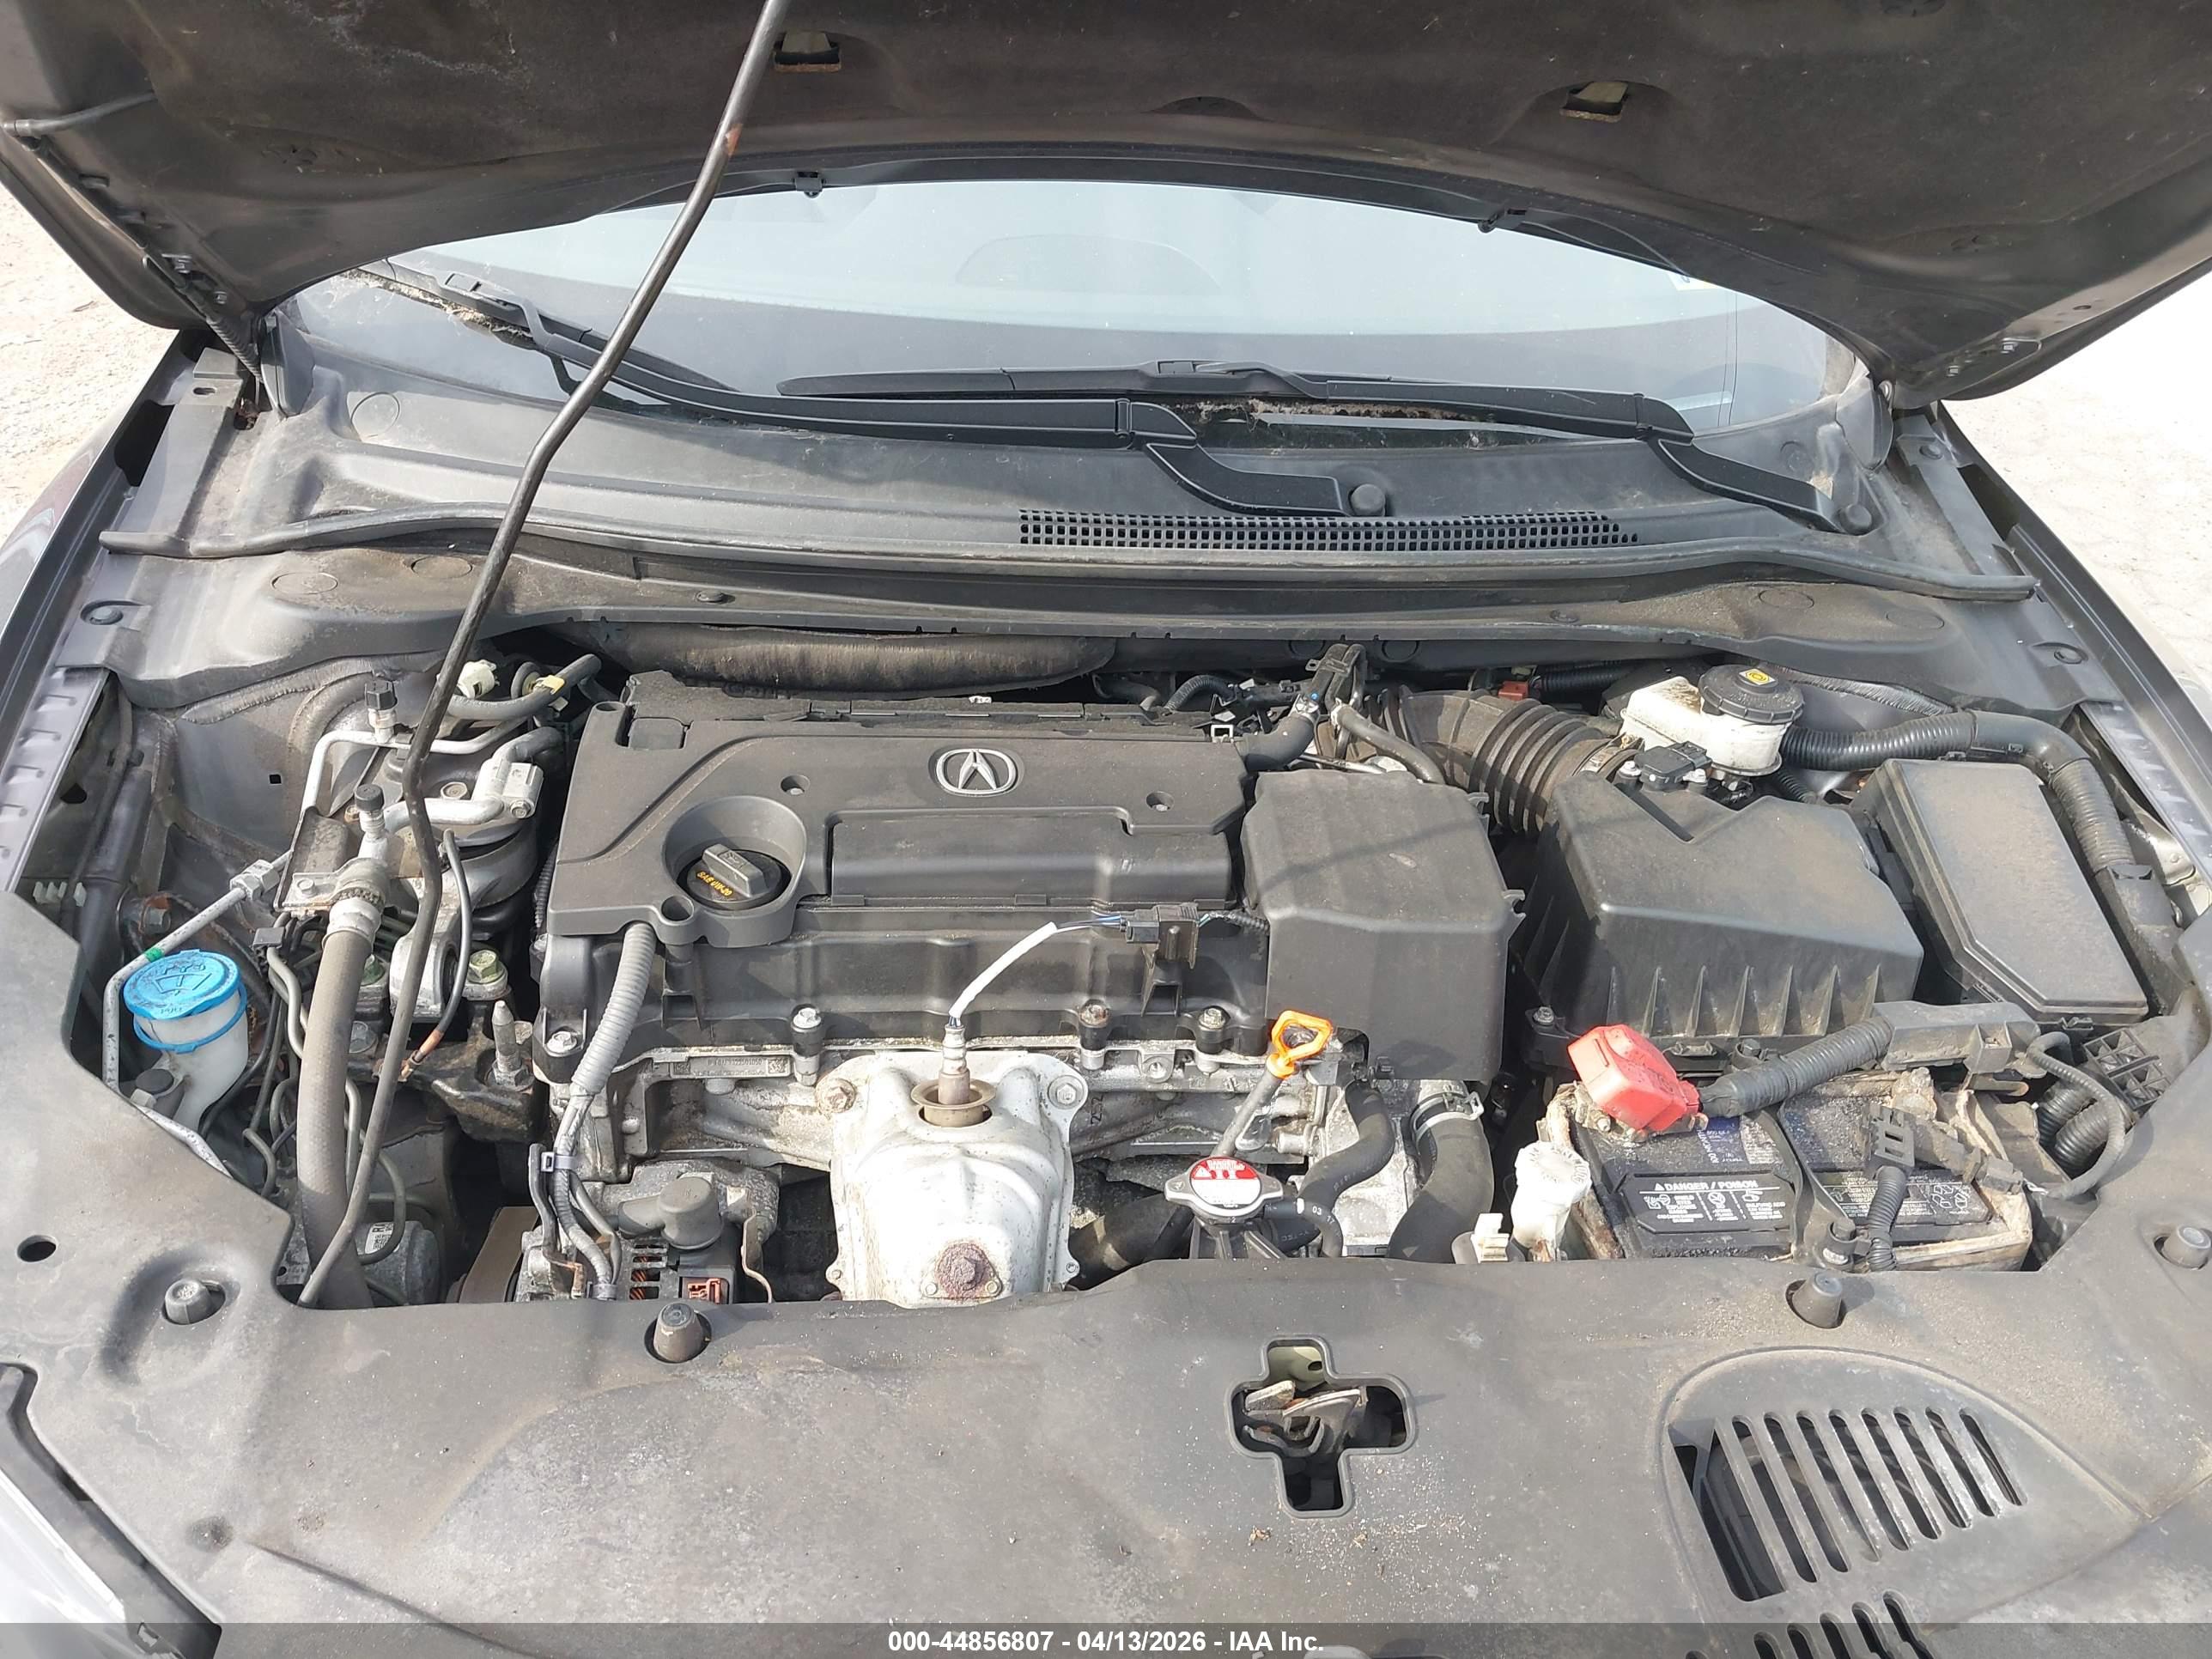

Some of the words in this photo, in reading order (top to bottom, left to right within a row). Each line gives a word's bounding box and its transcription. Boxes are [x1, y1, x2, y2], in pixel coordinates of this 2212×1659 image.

[696, 871, 714, 883] SAE
[1664, 1182, 1710, 1191] DANGER
[1717, 1180, 1759, 1189] POISON
[1312, 1206, 1322, 1216] 03
